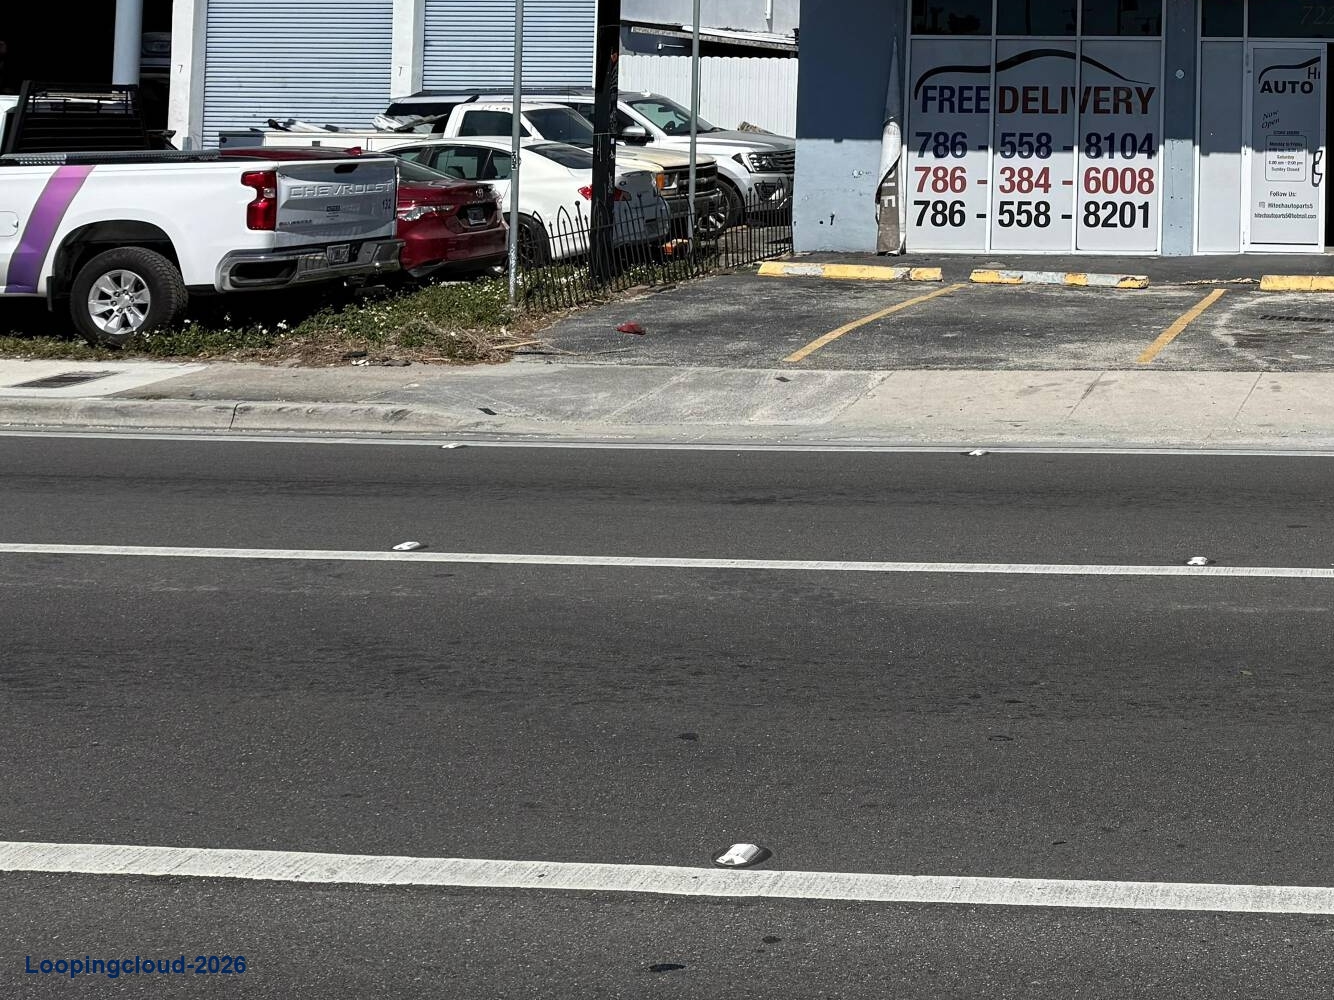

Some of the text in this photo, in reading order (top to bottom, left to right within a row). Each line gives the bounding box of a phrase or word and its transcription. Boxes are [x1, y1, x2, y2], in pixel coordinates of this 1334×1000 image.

[921, 85, 1156, 115] FREE DELIVERY
[1260, 81, 1314, 94] AUTO
[914, 131, 968, 159] 786
[1000, 132, 1053, 159] 558
[1085, 132, 1153, 160] 8104
[289, 180, 394, 198] CHEVROLET
[914, 166, 967, 194] 786
[999, 166, 1051, 194] 384
[1084, 166, 1154, 195] 6008
[913, 200, 966, 227] 786
[998, 200, 1051, 228] 558
[1083, 201, 1150, 228] 8201
